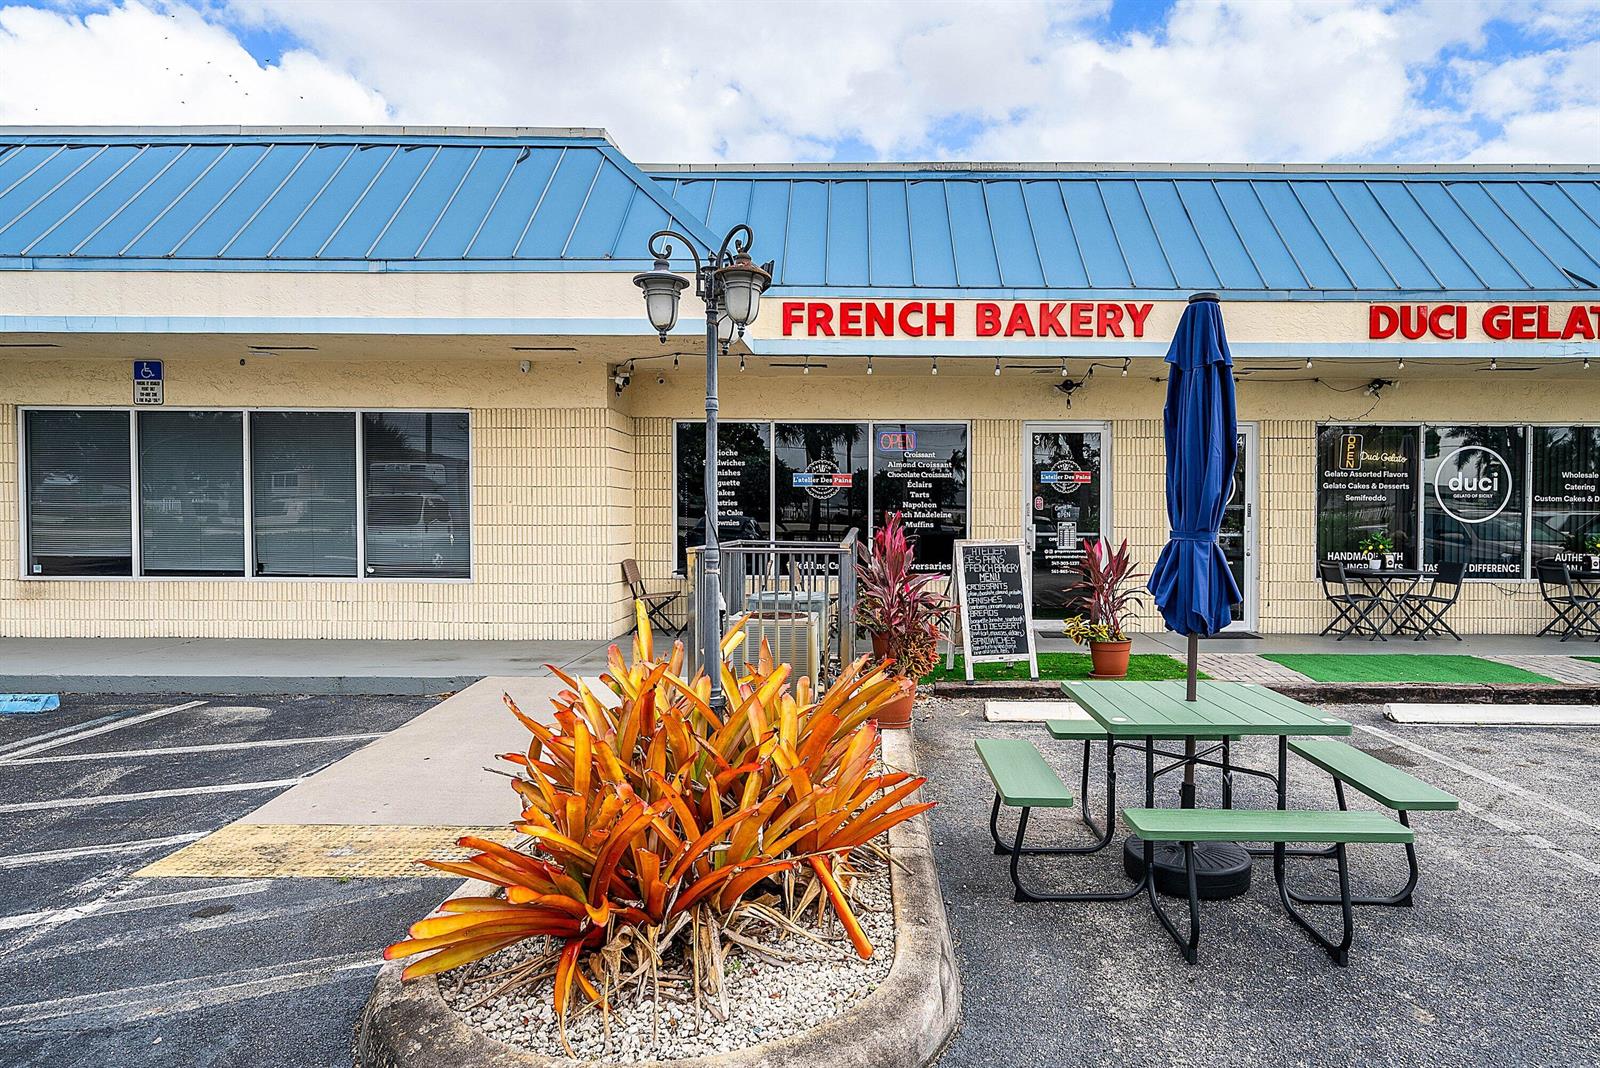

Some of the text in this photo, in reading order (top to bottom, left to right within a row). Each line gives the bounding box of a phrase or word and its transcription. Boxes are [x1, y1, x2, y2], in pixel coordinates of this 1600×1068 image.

[782, 302, 1154, 338] FRENCH BAKERY
[1369, 304, 1467, 340] DUCI
[880, 433, 915, 450] OPEN
[1033, 434, 1041, 446] 3
[1345, 435, 1357, 469] OPEN
[1380, 452, 1408, 463] Gelato
[717, 480, 741, 488] guette
[907, 479, 933, 488] Éclairs
[1448, 471, 1498, 491] duci
[1564, 483, 1596, 492] Catering
[1345, 494, 1387, 502] Semifreddo
[902, 501, 937, 509] Napoleon
[1554, 553, 1585, 562] AUTHE
[1469, 563, 1520, 573] DIFFERENCE
[979, 572, 1001, 581] MENU
